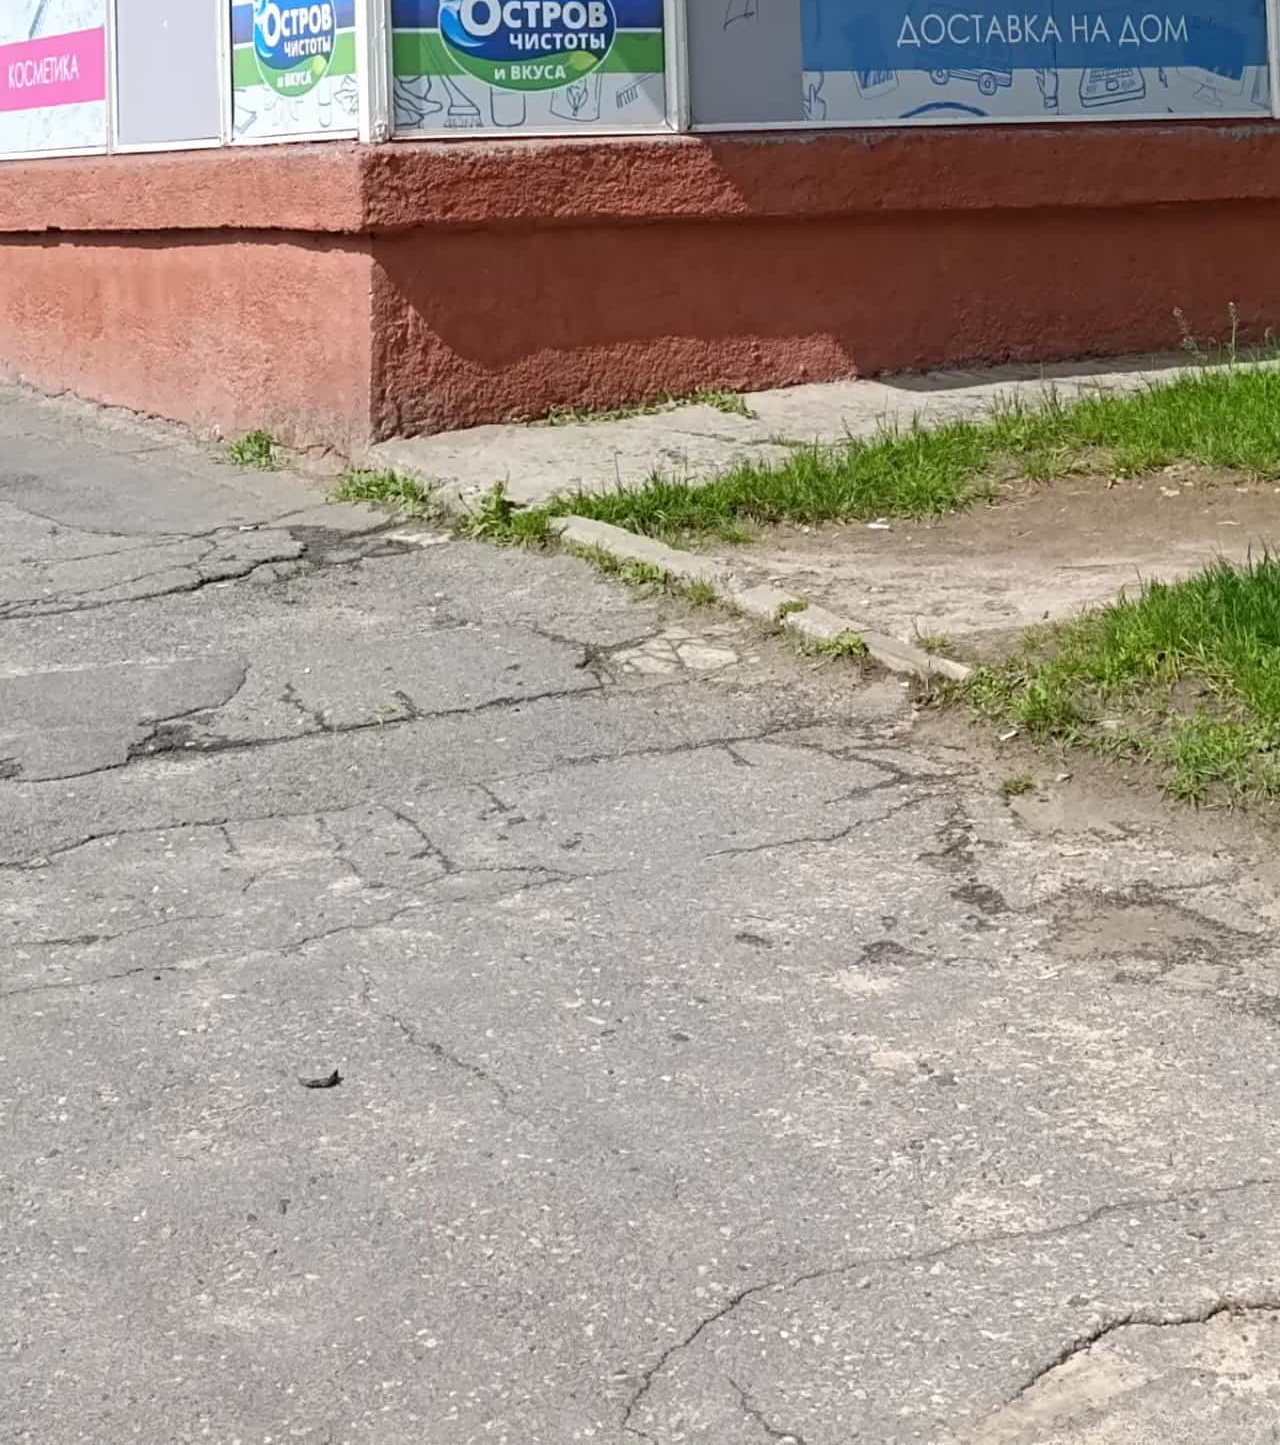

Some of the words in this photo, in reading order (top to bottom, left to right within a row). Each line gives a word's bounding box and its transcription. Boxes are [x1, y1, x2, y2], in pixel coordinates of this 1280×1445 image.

[261, 2, 333, 48] ОСТРОВ
[897, 14, 1063, 48] ДОСТАВКА
[1071, 14, 1111, 43] НА
[1118, 14, 1189, 47] ДОМ
[283, 35, 332, 58] ЧИСТОТЫ
[509, 33, 606, 50] ЧИСТОТЫ
[8, 54, 80, 89] КОСМЕТИКА
[510, 65, 567, 81] ВКУСА
